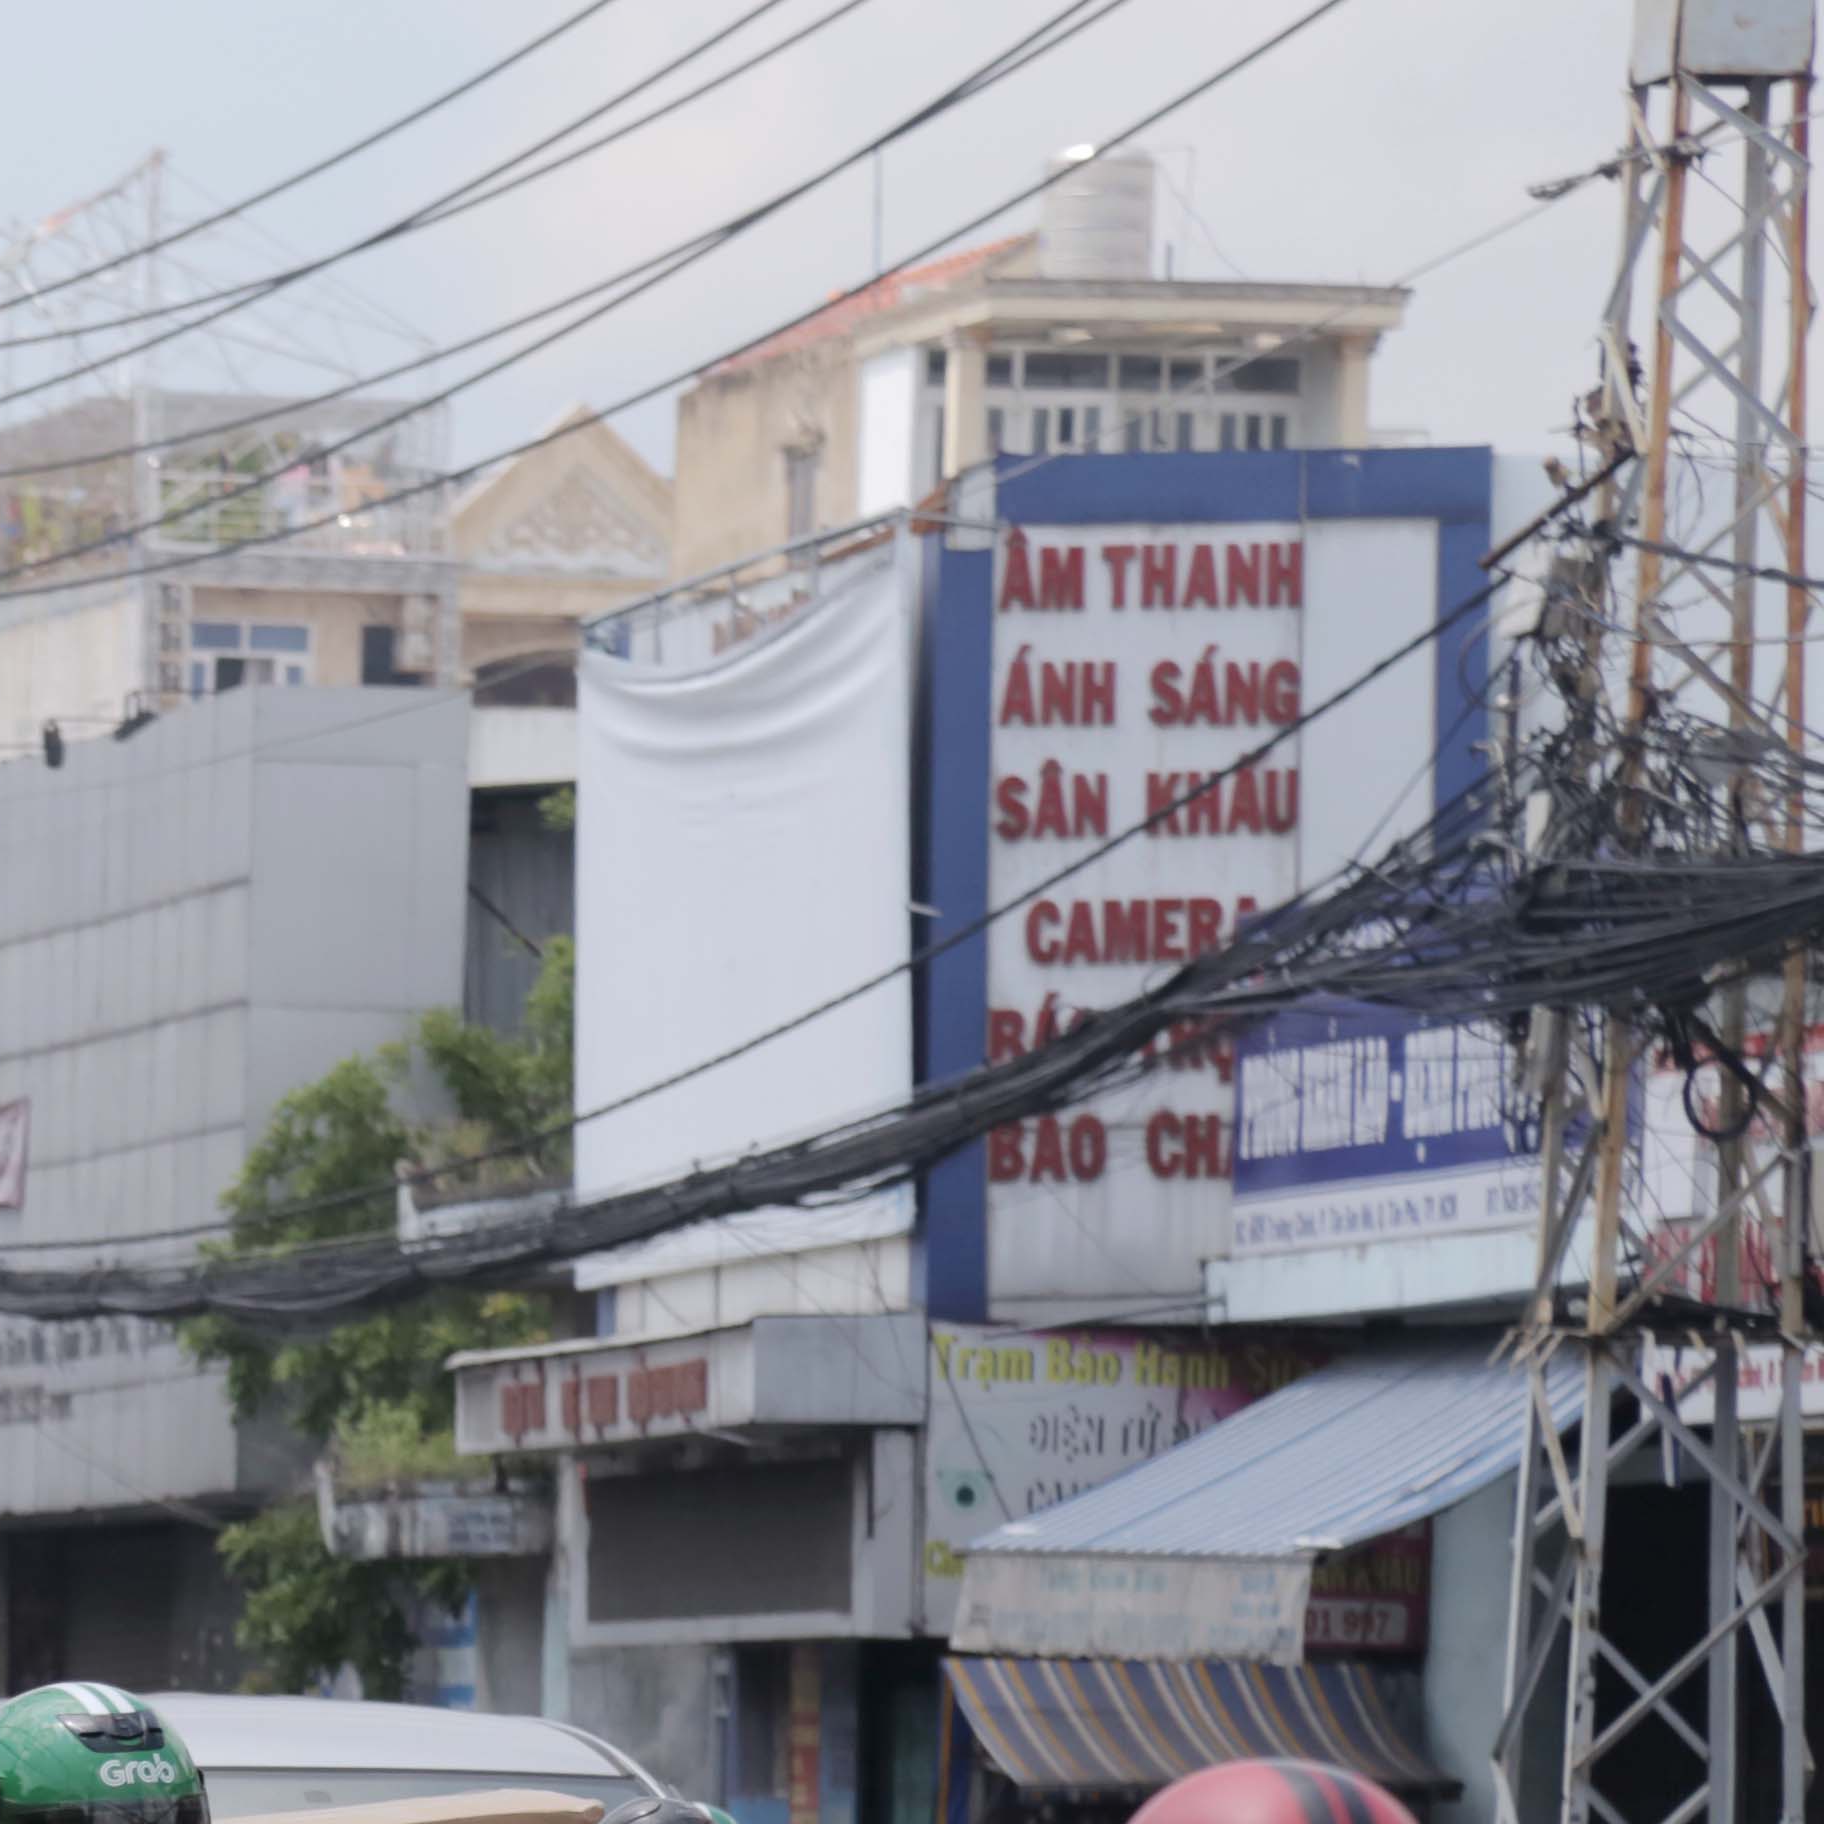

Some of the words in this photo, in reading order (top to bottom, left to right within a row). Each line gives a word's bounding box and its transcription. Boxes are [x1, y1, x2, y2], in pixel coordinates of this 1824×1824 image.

[1000, 525, 1085, 613] ÂM
[1102, 541, 1303, 612] THANH
[1000, 643, 1116, 728] ÁNH
[1148, 643, 1301, 731] SÁNG
[995, 758, 1109, 843] SÂN
[100, 1753, 175, 1788] Grab
